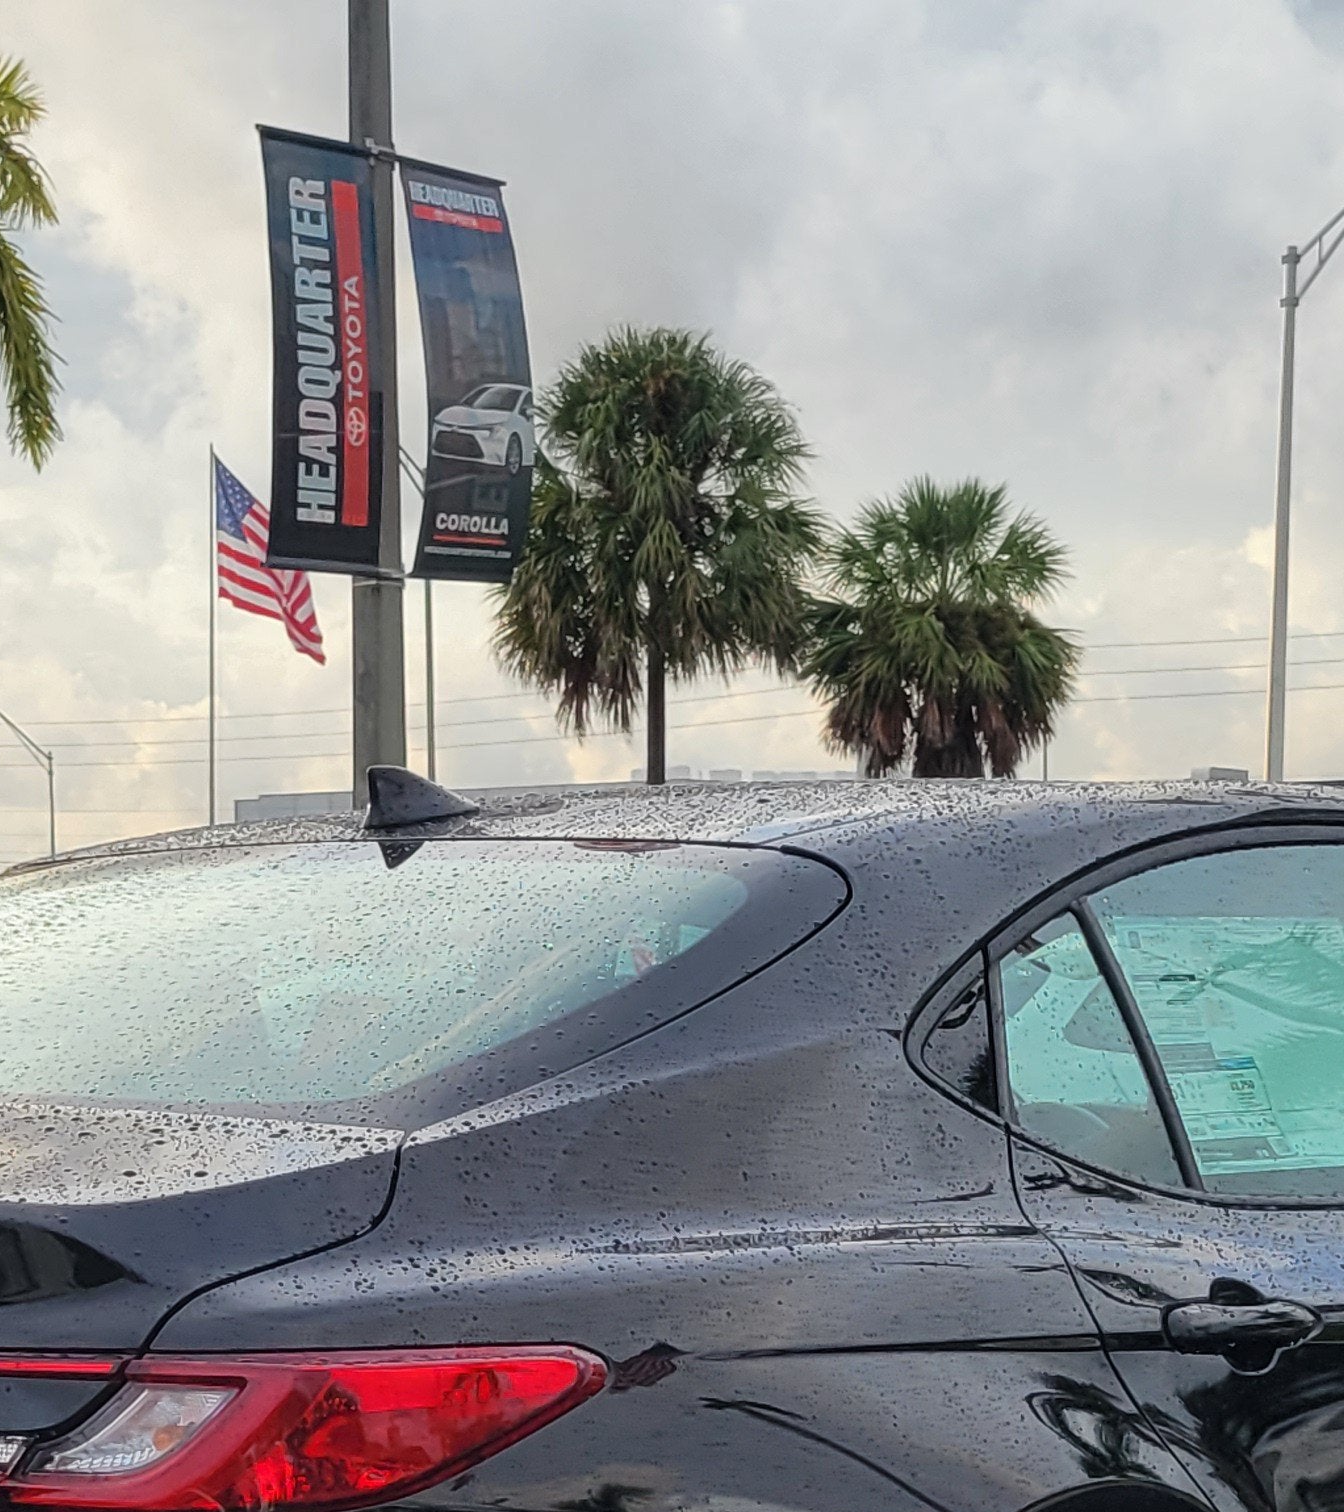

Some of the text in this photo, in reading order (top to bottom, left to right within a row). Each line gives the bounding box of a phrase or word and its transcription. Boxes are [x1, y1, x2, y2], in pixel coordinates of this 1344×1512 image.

[287, 175, 342, 526] HEADQUARTER
[344, 276, 367, 403] TOYOTA
[435, 512, 509, 535] COROLLA
